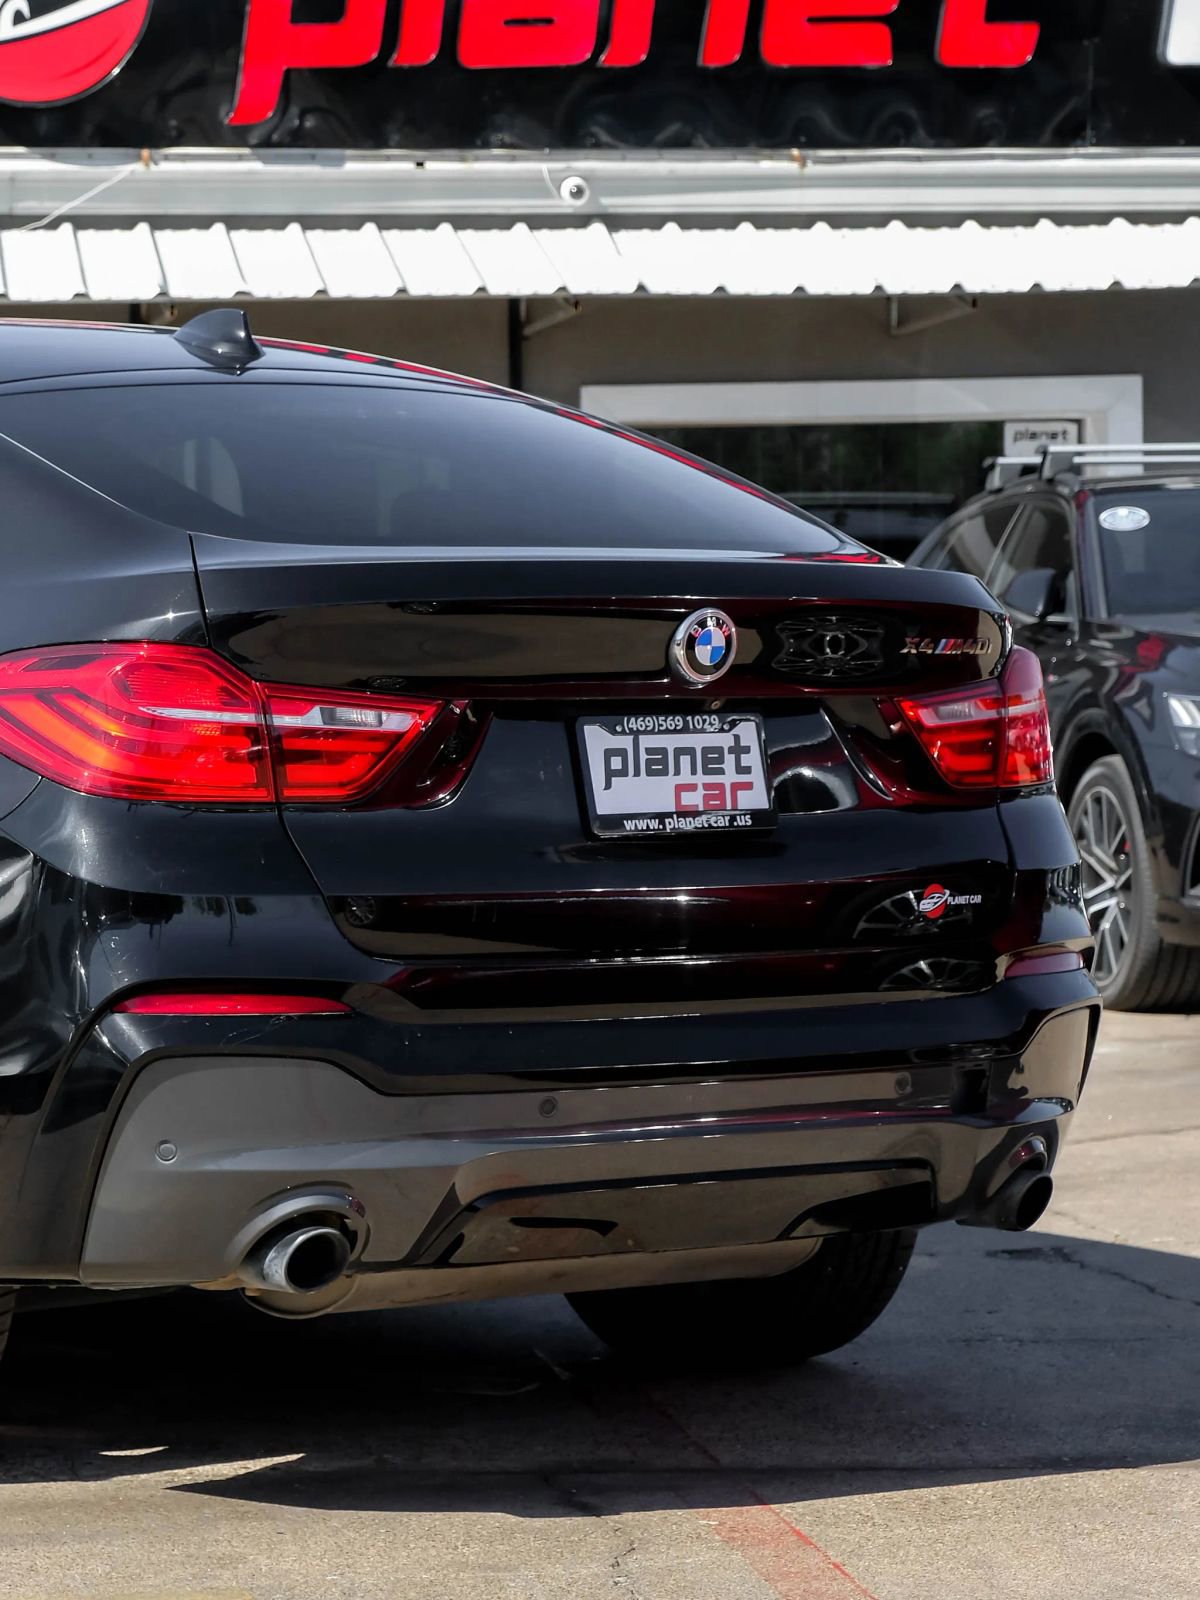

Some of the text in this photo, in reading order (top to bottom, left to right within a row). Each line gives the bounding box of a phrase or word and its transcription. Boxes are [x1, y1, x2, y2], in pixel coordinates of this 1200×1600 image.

[1012, 427, 1068, 444] planet
[690, 615, 731, 638] BMW
[900, 637, 934, 654] X4
[623, 714, 720, 733] (469)569 1029
[603, 734, 753, 790] planet
[674, 781, 754, 812] car
[623, 818, 663, 831] www.
[733, 814, 752, 827] .us
[947, 894, 982, 905] PLANET CAR
